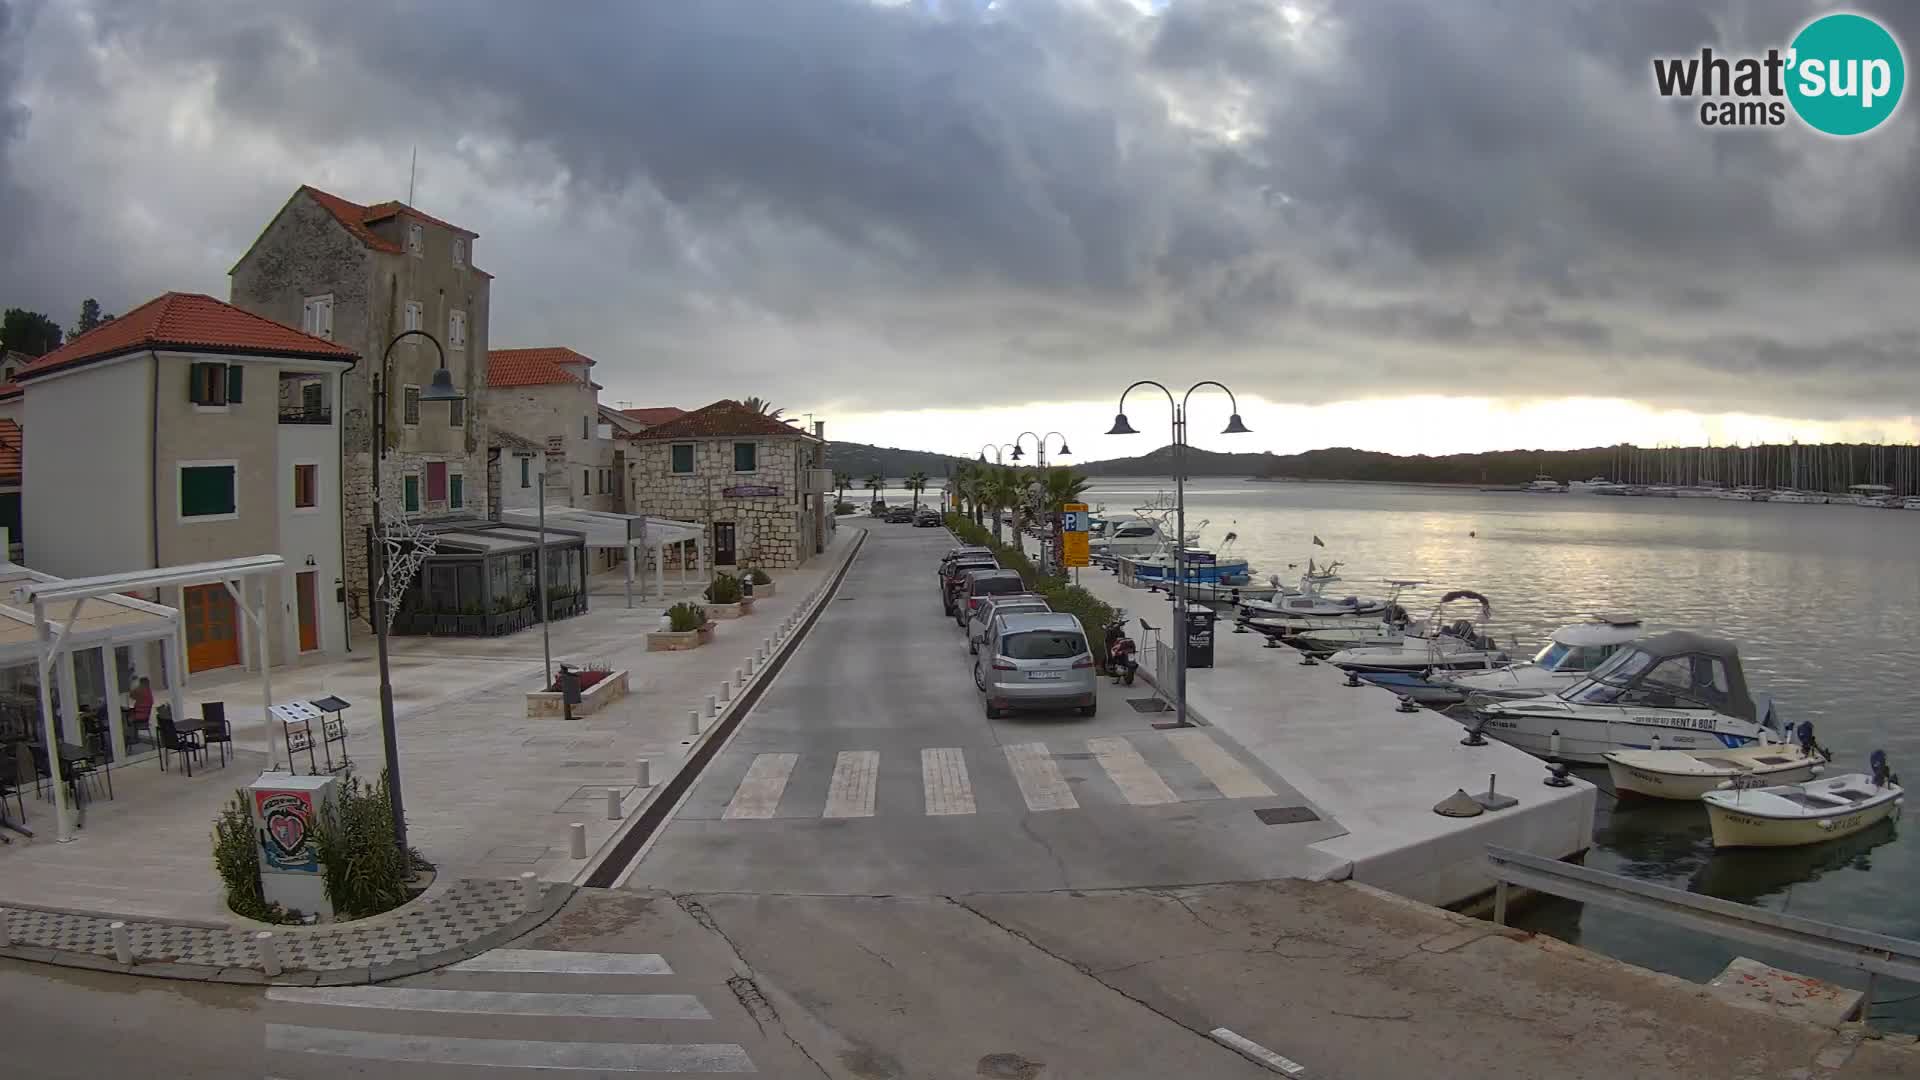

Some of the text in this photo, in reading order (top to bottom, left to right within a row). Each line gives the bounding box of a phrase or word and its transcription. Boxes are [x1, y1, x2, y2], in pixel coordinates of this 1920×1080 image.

[1670, 717, 1691, 727] RENT
[1692, 718, 1698, 728] A
[1699, 718, 1718, 730] BOAT
